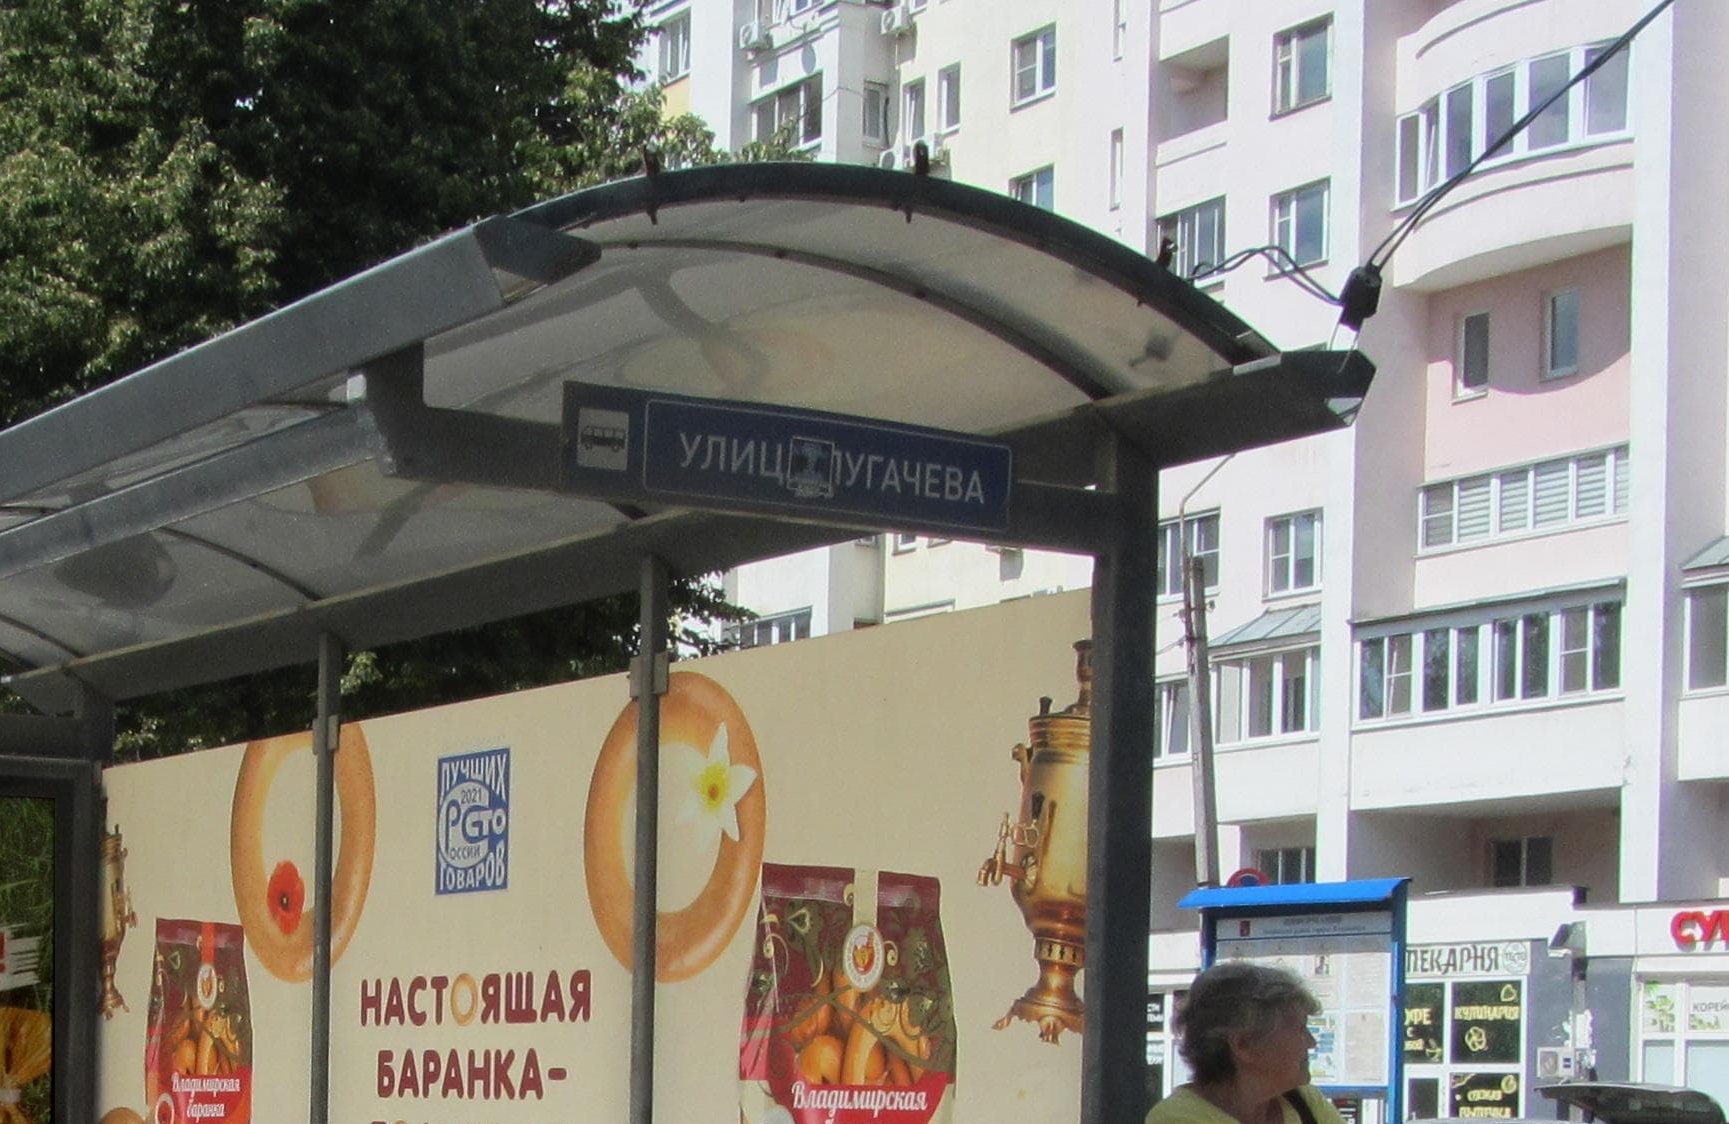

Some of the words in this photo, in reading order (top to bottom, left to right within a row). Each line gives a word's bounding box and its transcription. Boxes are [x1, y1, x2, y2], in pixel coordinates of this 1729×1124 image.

[439, 753, 508, 806] ЛУЧШИХ
[460, 788, 483, 806] 2021
[438, 840, 505, 891] ТОВАРОВ
[1671, 910, 1729, 946] СУ
[1406, 944, 1499, 975] ПЕКАРНЯ
[360, 969, 592, 1027] НАСТОЯЩАЯ
[790, 1081, 929, 1119] Владимирская
